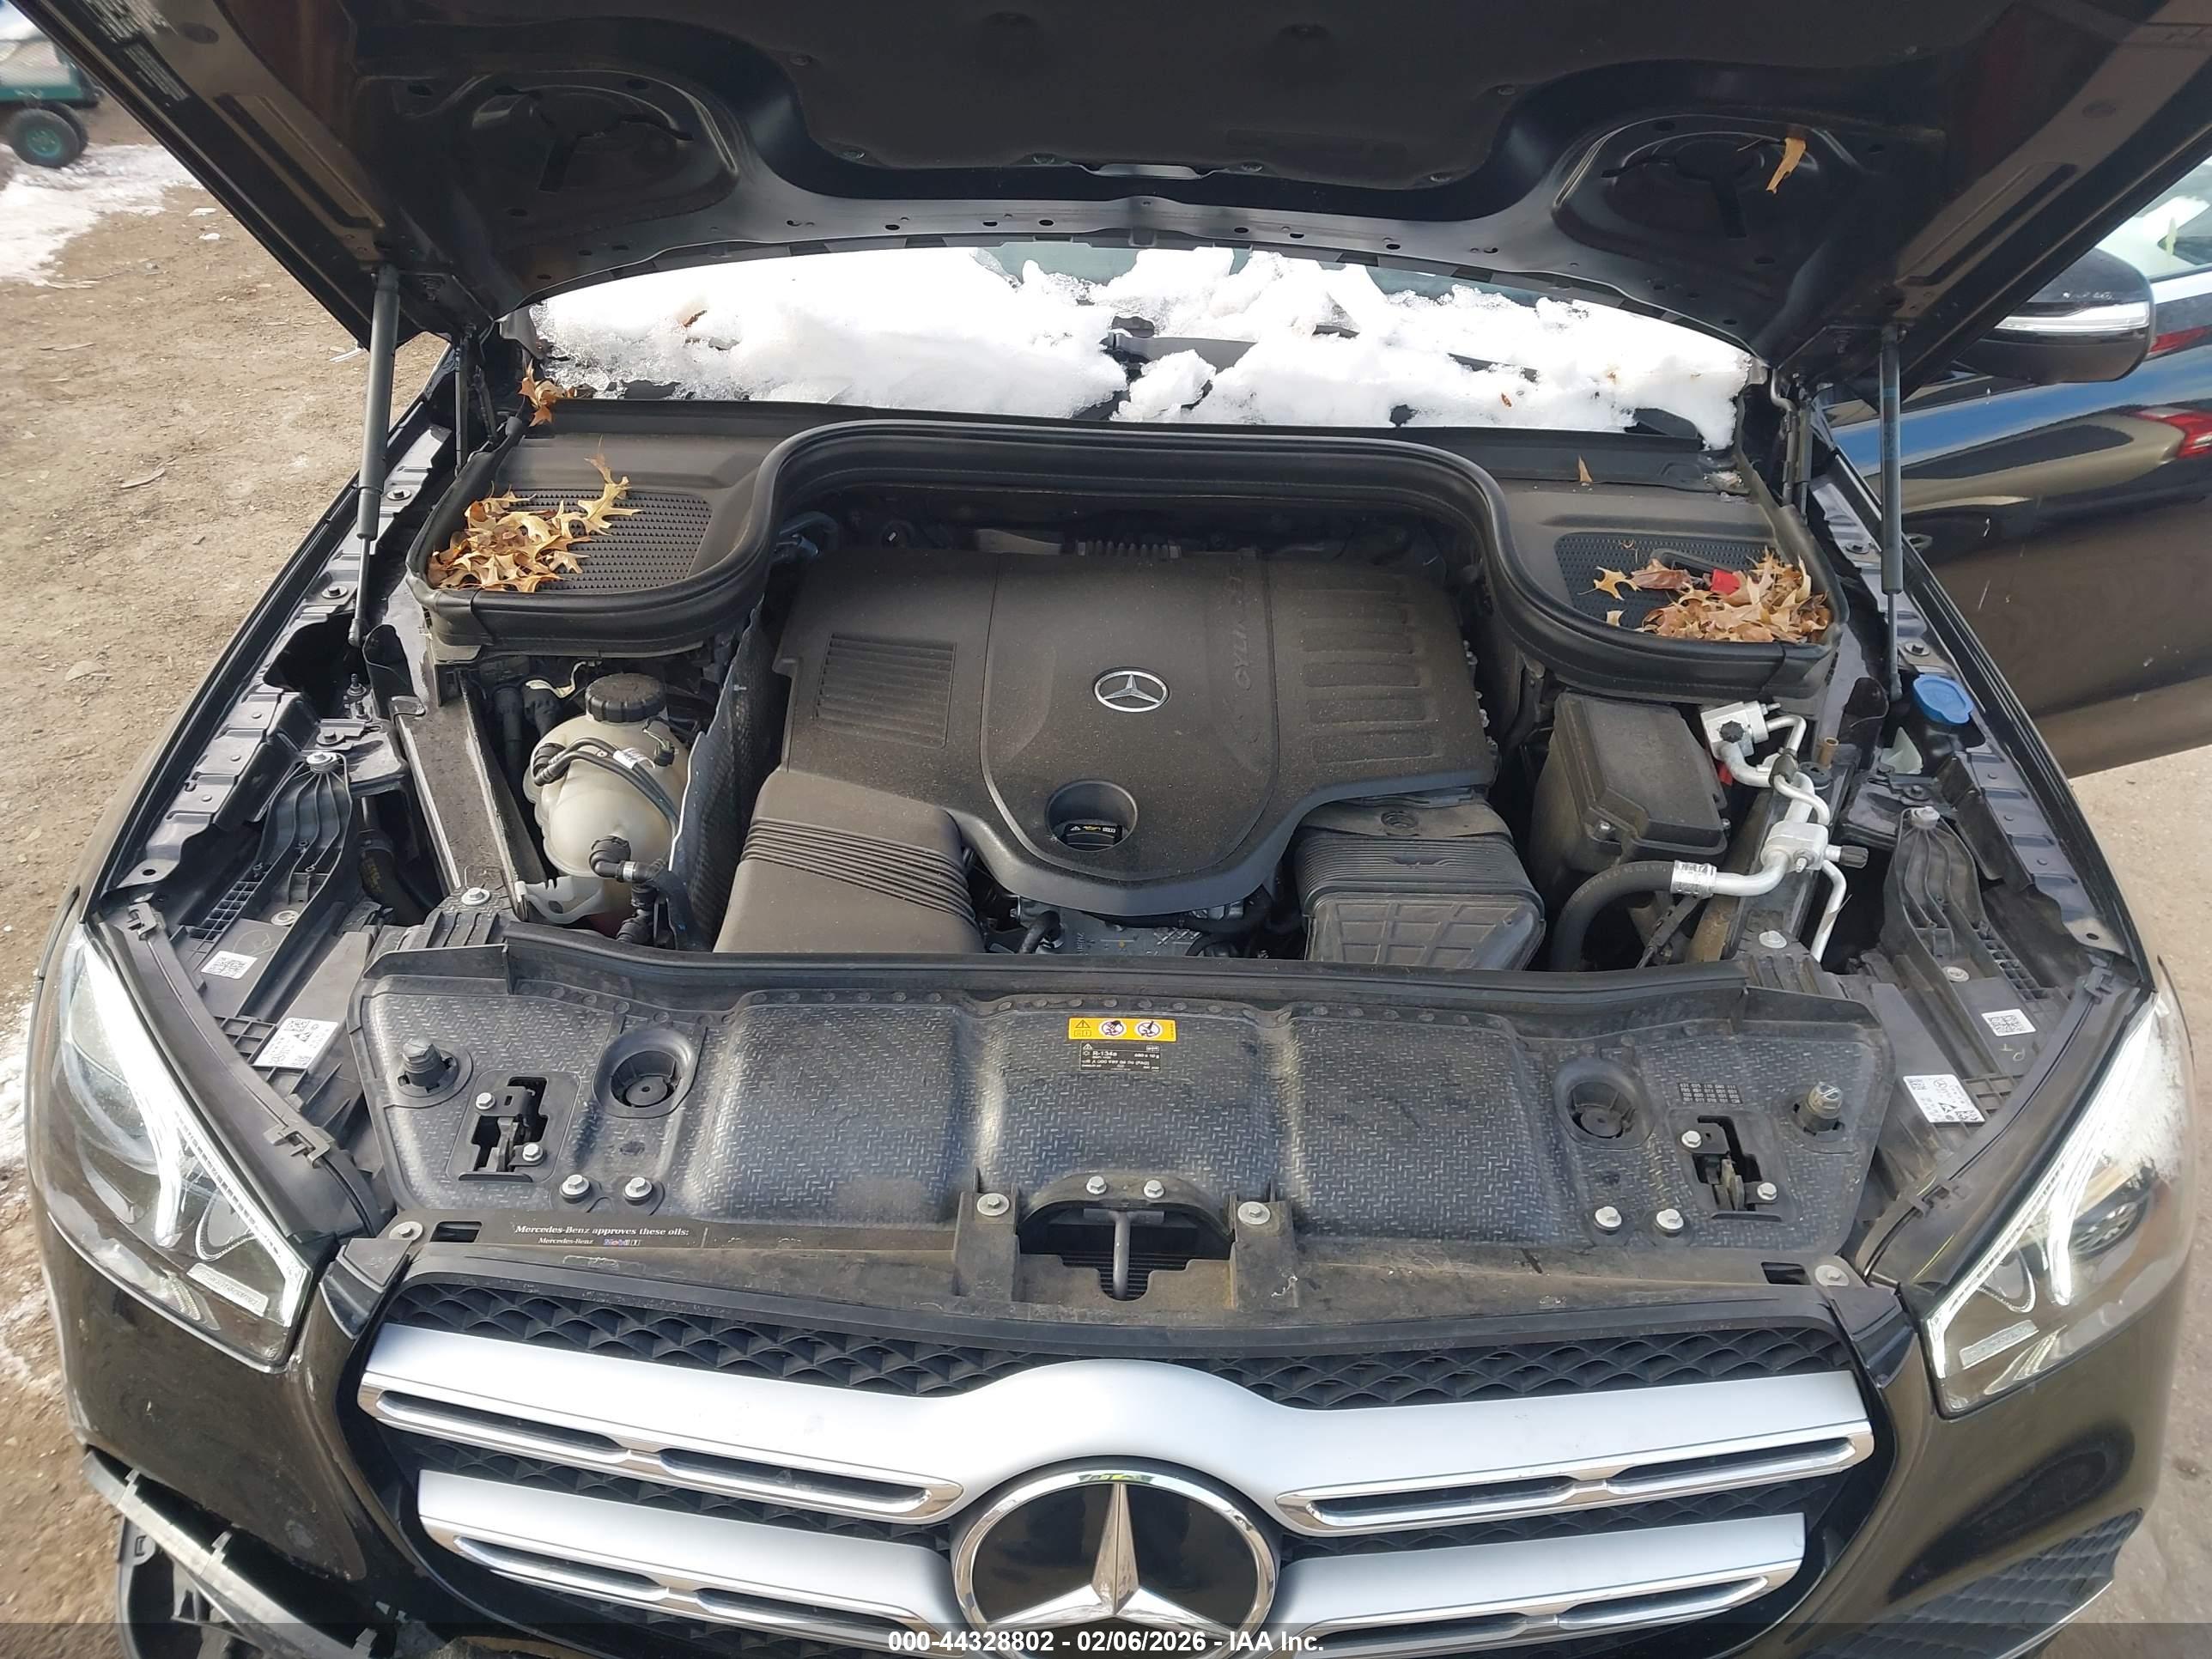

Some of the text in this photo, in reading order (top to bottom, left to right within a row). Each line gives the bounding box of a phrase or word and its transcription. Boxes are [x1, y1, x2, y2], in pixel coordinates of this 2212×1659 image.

[515, 1225, 591, 1234] Mercedes-Benz
[639, 1227, 666, 1236] these
[668, 1227, 690, 1236] oils:
